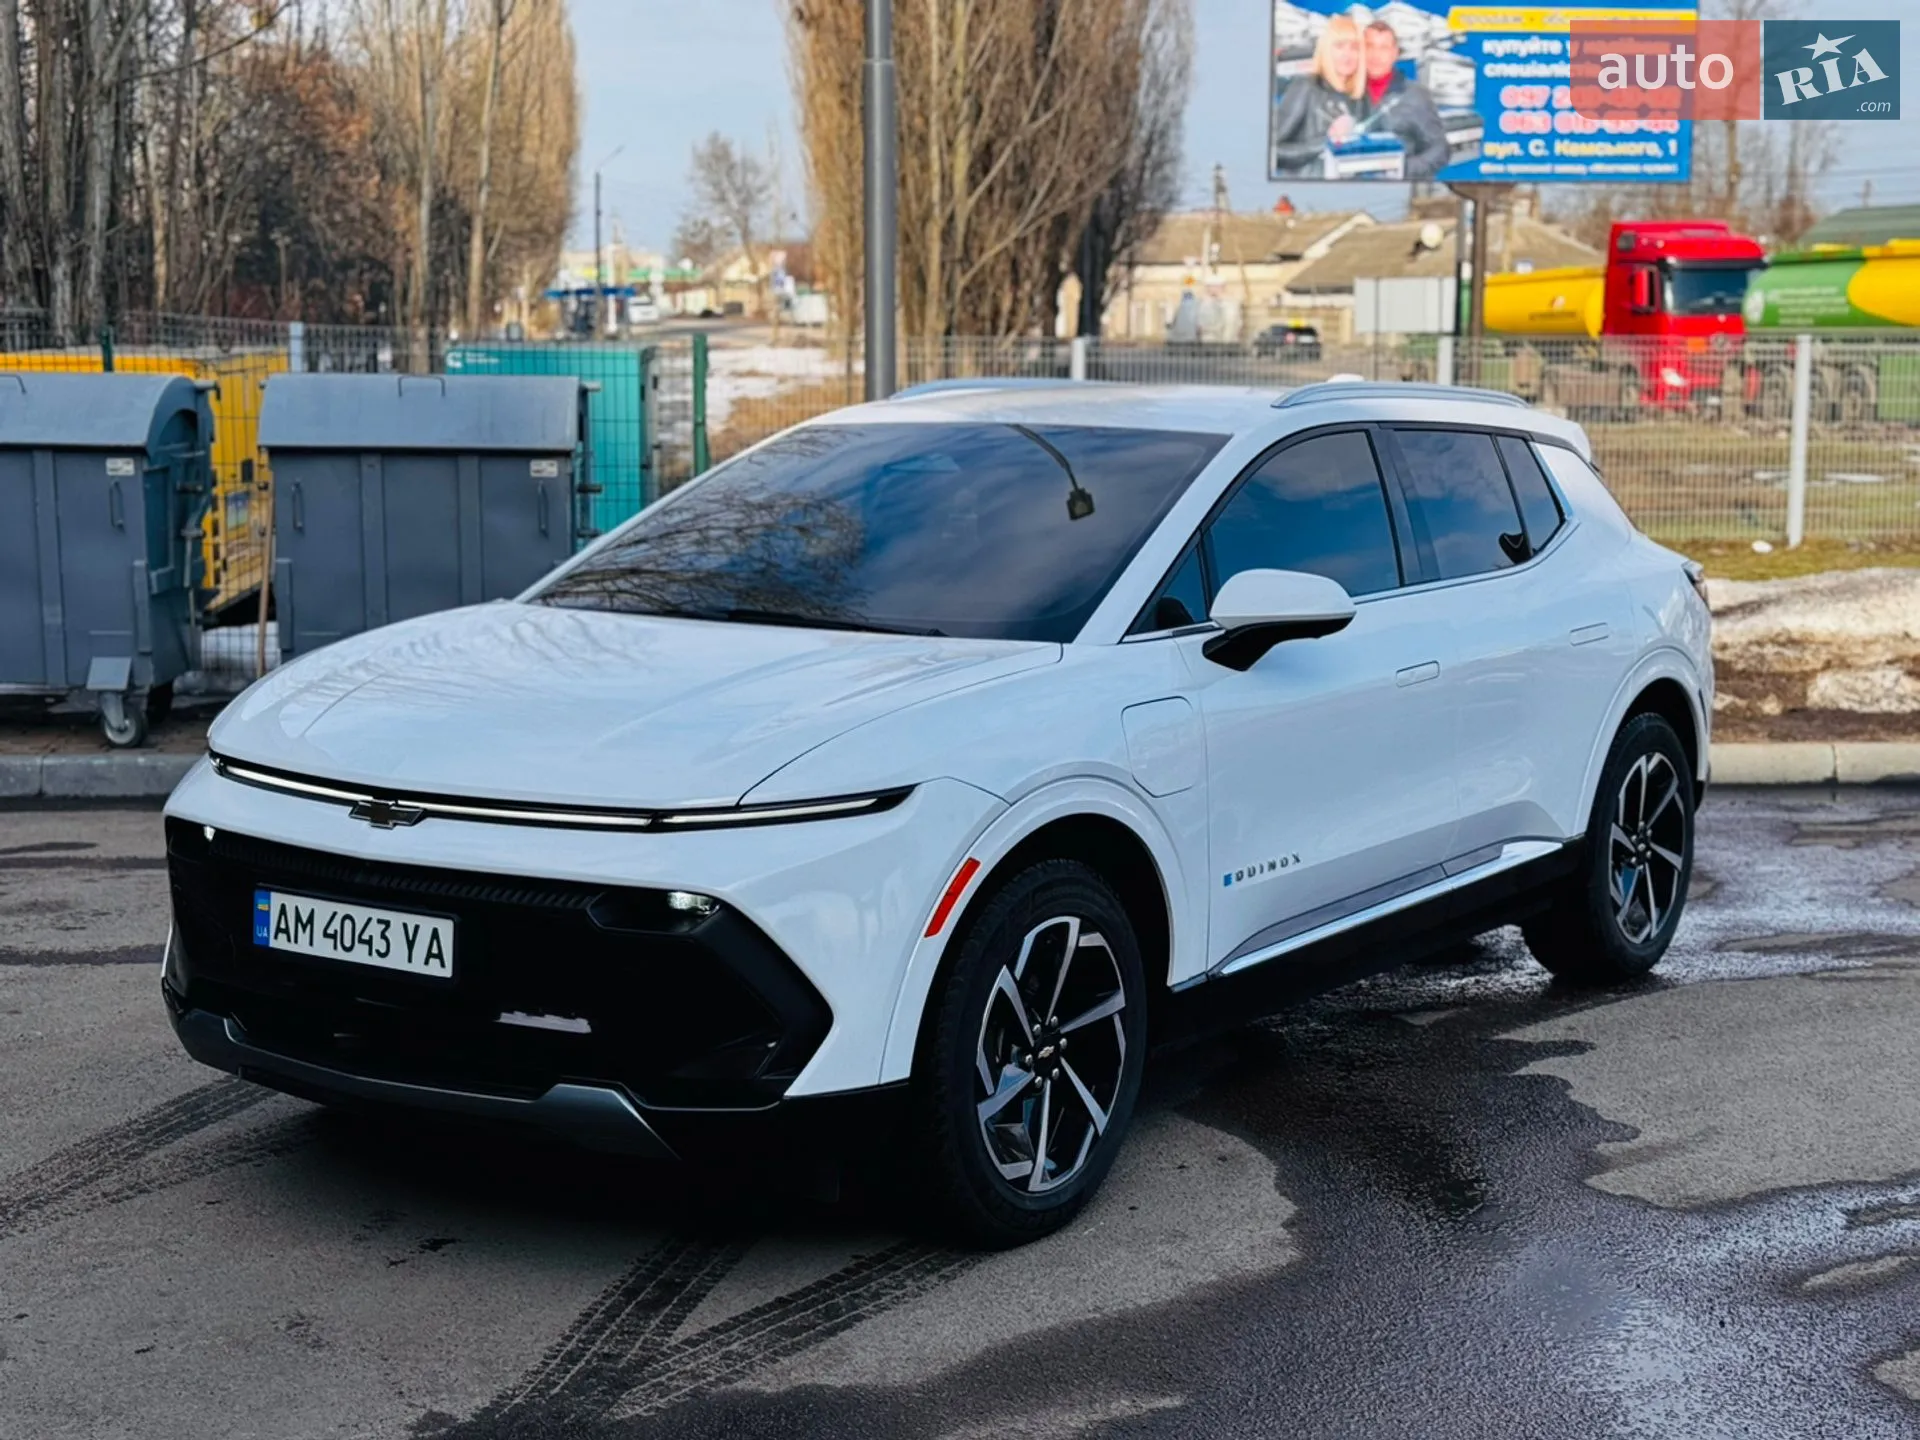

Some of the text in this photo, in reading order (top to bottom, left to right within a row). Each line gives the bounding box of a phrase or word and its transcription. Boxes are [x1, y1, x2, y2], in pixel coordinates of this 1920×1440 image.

[1223, 851, 1301, 887] EQUINOX
[256, 925, 268, 938] UA
[273, 902, 446, 969] AM 4043 YA
